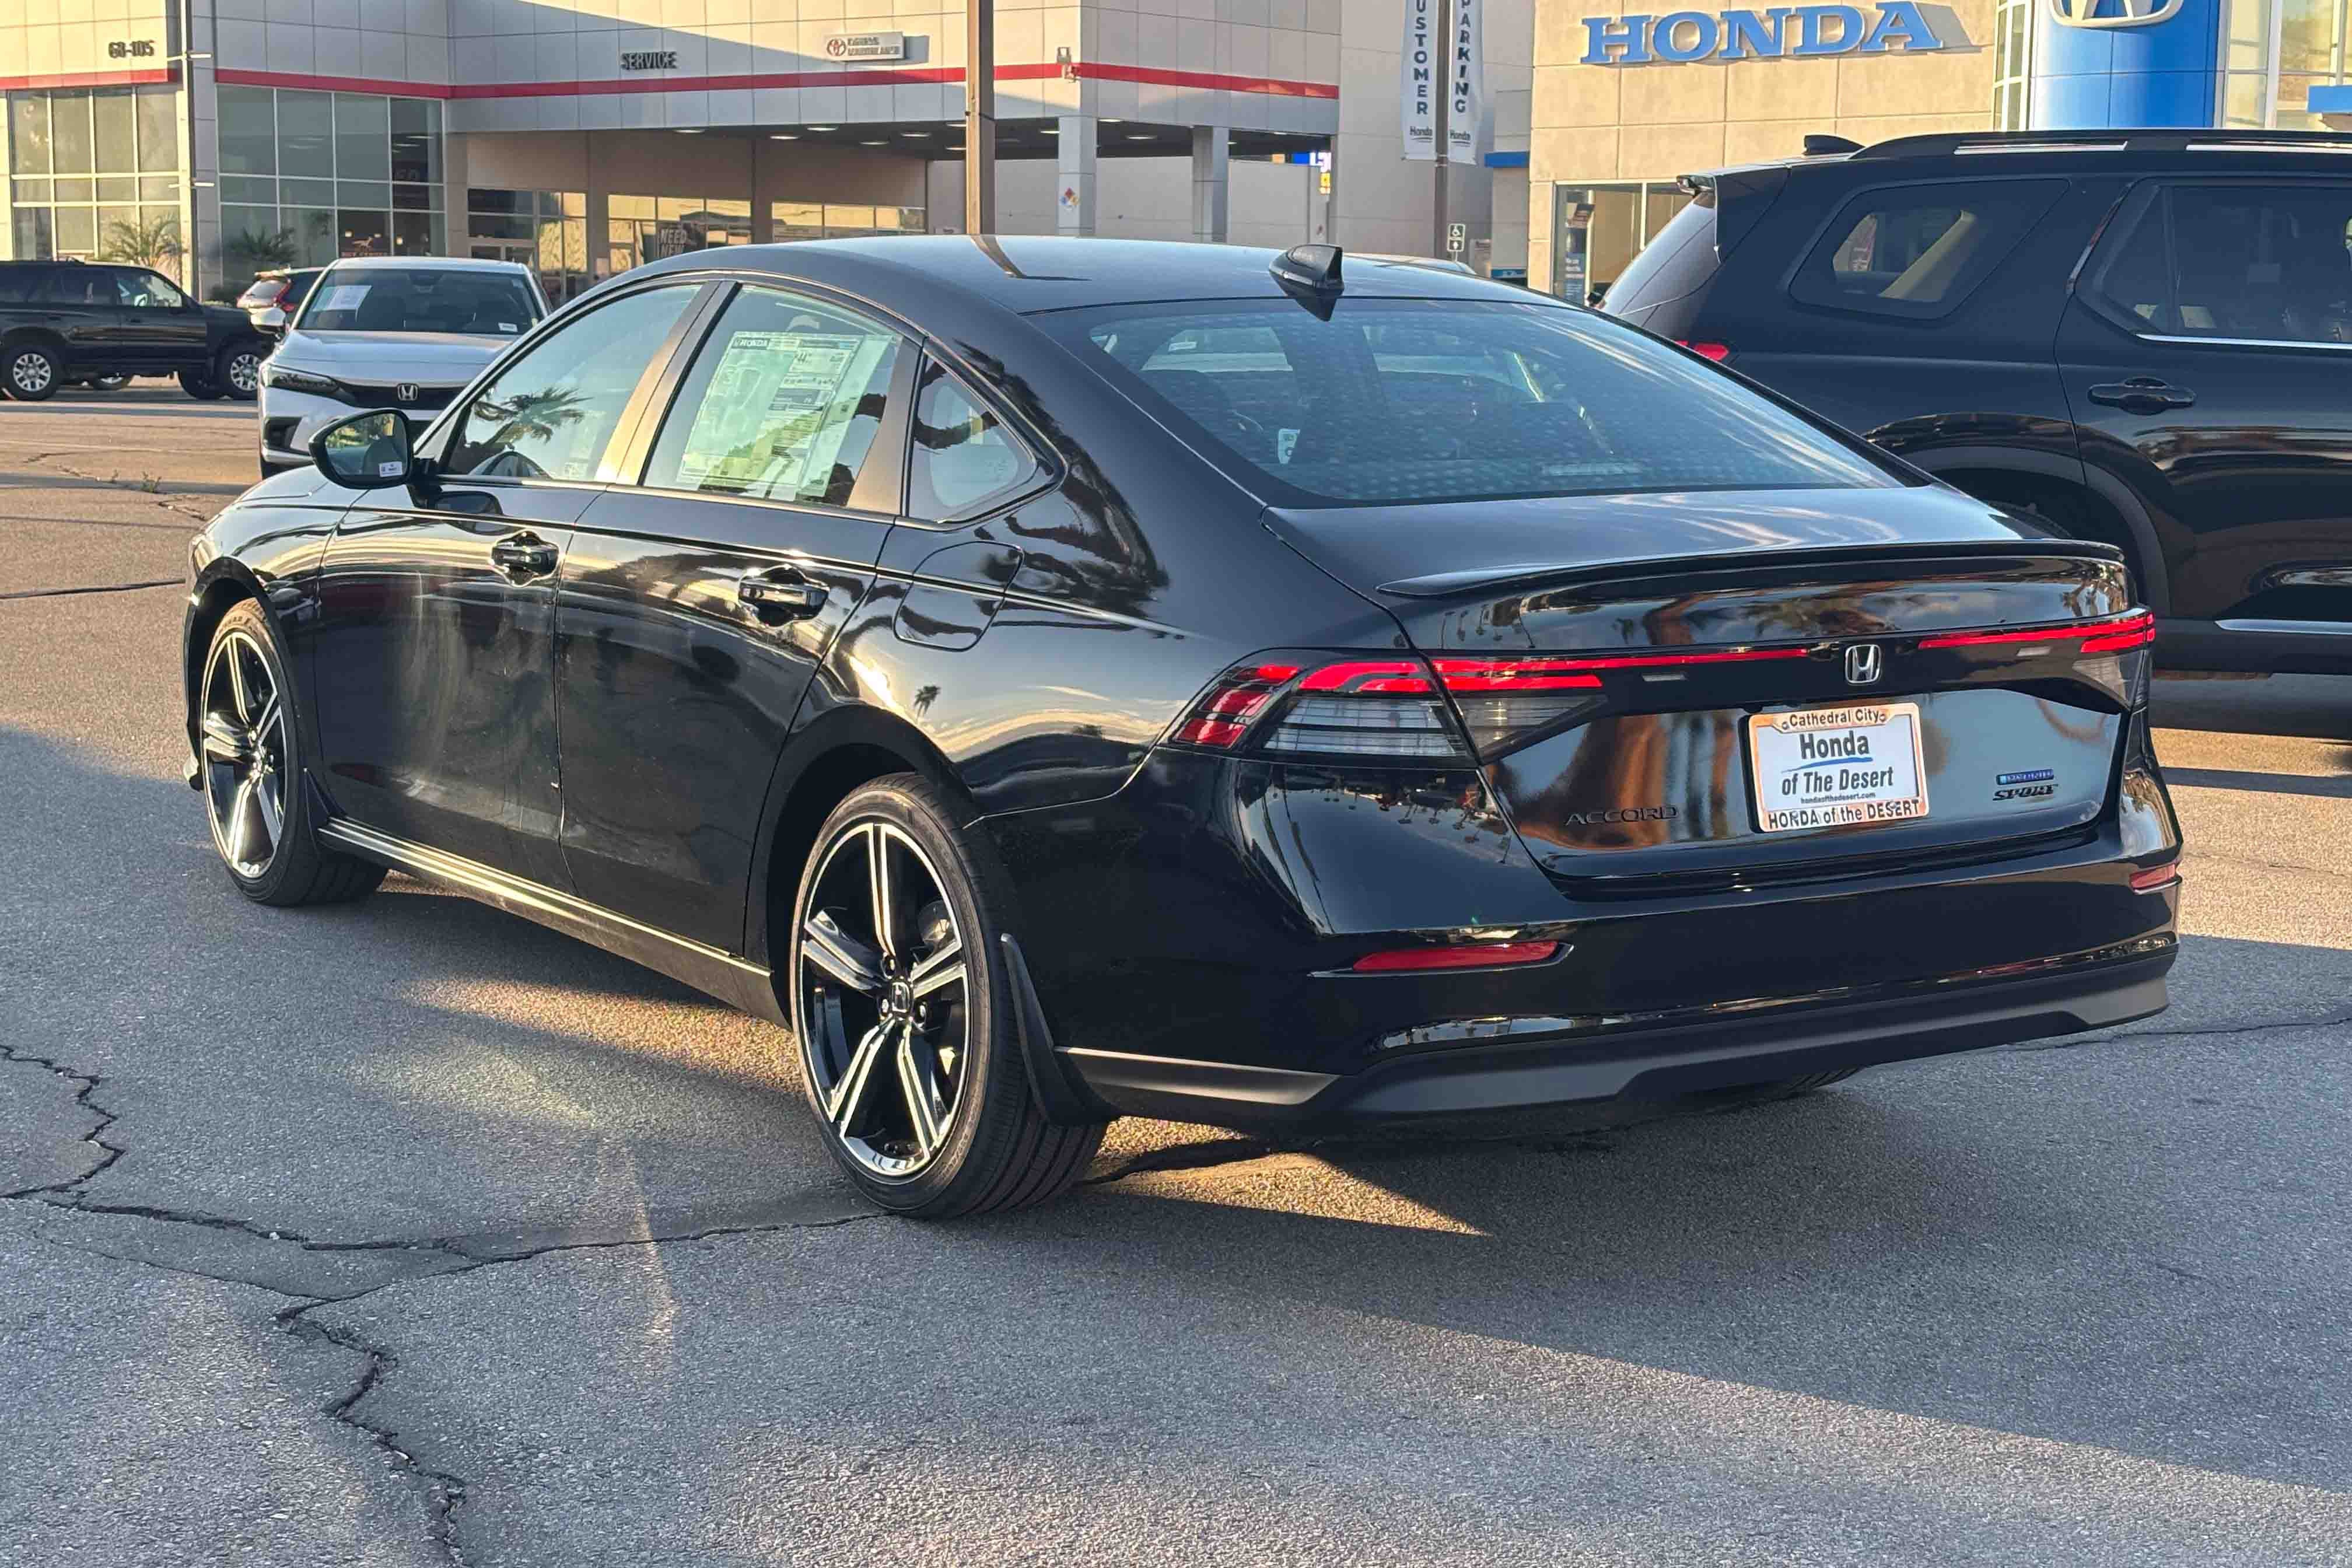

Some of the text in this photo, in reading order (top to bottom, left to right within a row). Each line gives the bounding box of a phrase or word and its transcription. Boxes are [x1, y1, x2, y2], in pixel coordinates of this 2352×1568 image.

[1580, 1, 1944, 64] HONDA
[620, 51, 677, 70] SERVICE
[1455, 0, 1471, 113] PARKING
[659, 228, 687, 243] NEED
[1788, 708, 1880, 727] Cathedral City
[1800, 729, 1870, 760] Honda
[1782, 765, 1894, 796] of The Desert
[1800, 792, 1877, 804] hondaofthedesert.com
[1993, 783, 2059, 801] SPORT
[1564, 805, 1678, 827] ACCORD
[1824, 807, 1838, 824] of
[1841, 805, 1863, 821] the
[1867, 799, 1920, 820] DESERT
